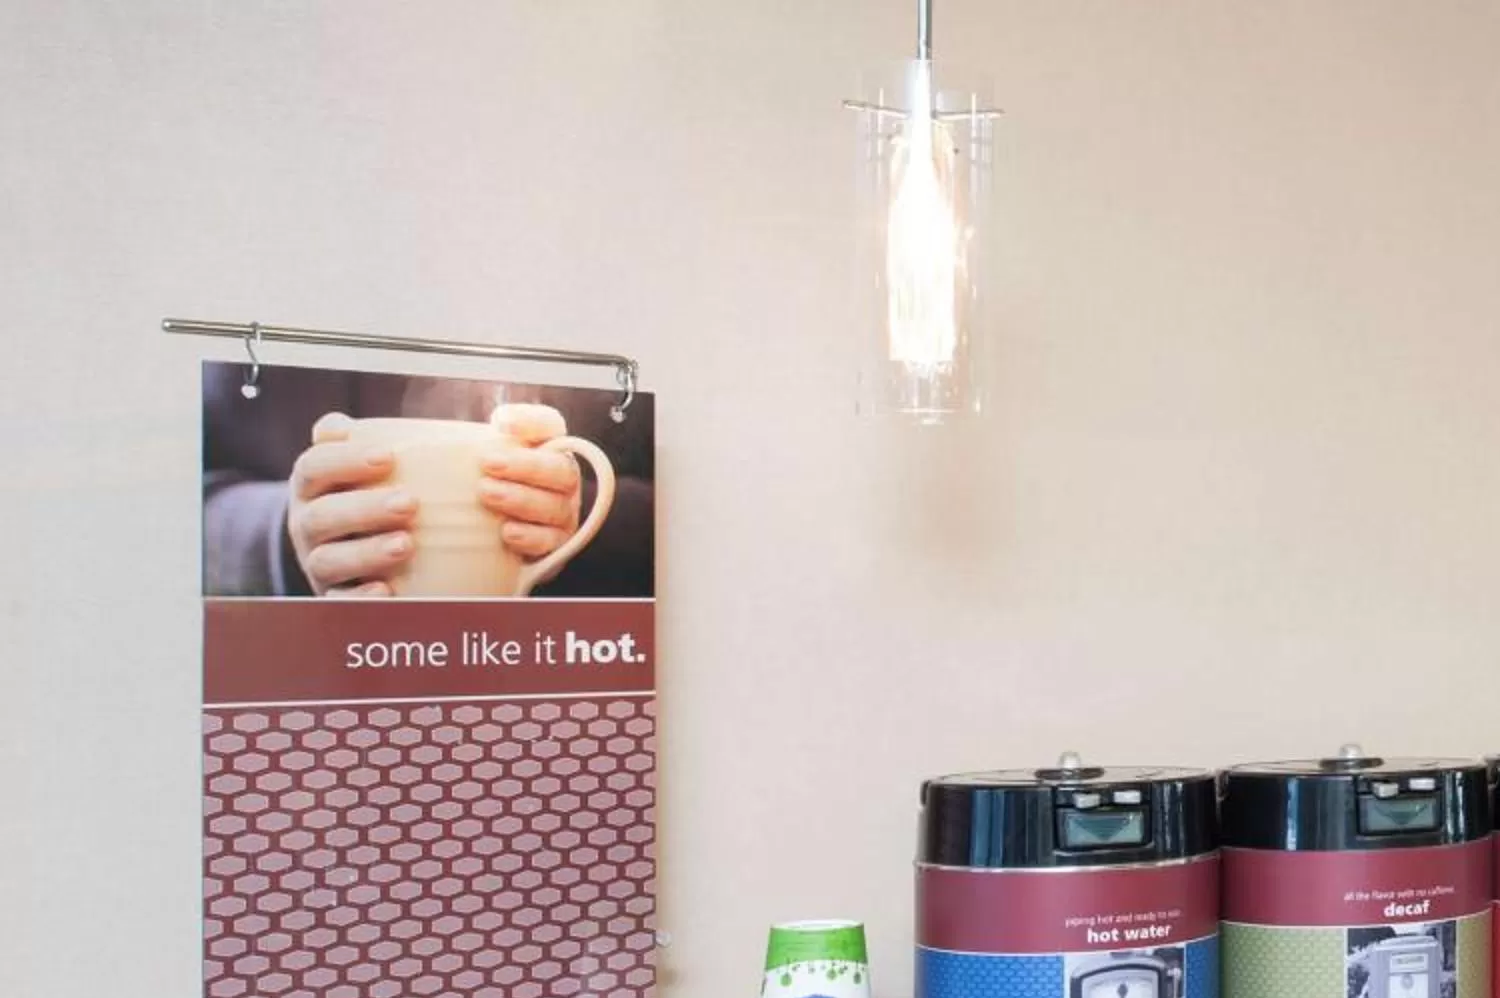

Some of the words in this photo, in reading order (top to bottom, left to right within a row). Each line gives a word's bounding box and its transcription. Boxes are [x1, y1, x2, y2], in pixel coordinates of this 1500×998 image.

[346, 638, 449, 668] some
[461, 631, 522, 666] like
[534, 632, 557, 665] it
[564, 631, 646, 664] hot.
[1383, 899, 1431, 918] decaf
[1086, 927, 1119, 944] hot
[1124, 924, 1173, 941] water
